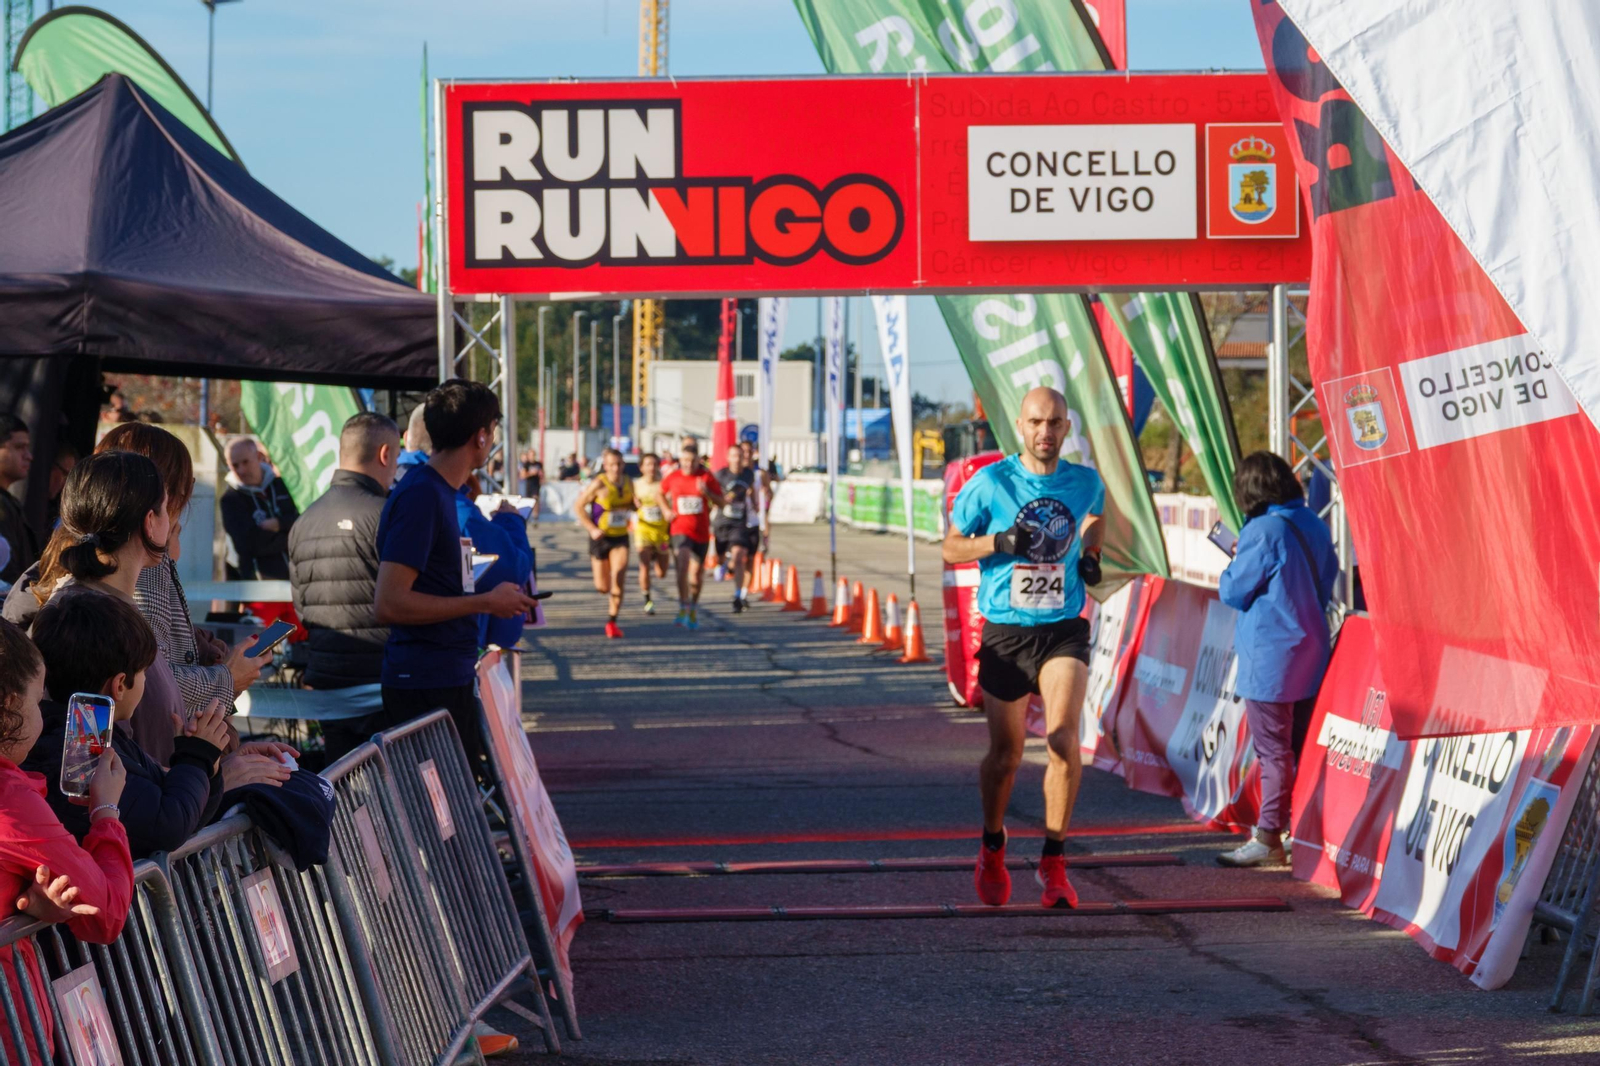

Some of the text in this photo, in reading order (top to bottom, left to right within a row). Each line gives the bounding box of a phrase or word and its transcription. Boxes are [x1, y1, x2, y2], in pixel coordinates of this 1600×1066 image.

[929, 89, 1272, 119] Subida Ao Castro 5+5
[473, 108, 676, 183] RUN
[986, 150, 1177, 178] CONCELLO
[1010, 186, 1156, 213] DE VIGO
[932, 249, 1037, 275] Cáncer
[1063, 247, 1128, 278] Vigo
[1211, 245, 1243, 271] La
[1256, 245, 1286, 271] 21
[1020, 576, 1064, 595] 224
[1405, 798, 1439, 863] DE
[1431, 804, 1476, 877] VIGO
